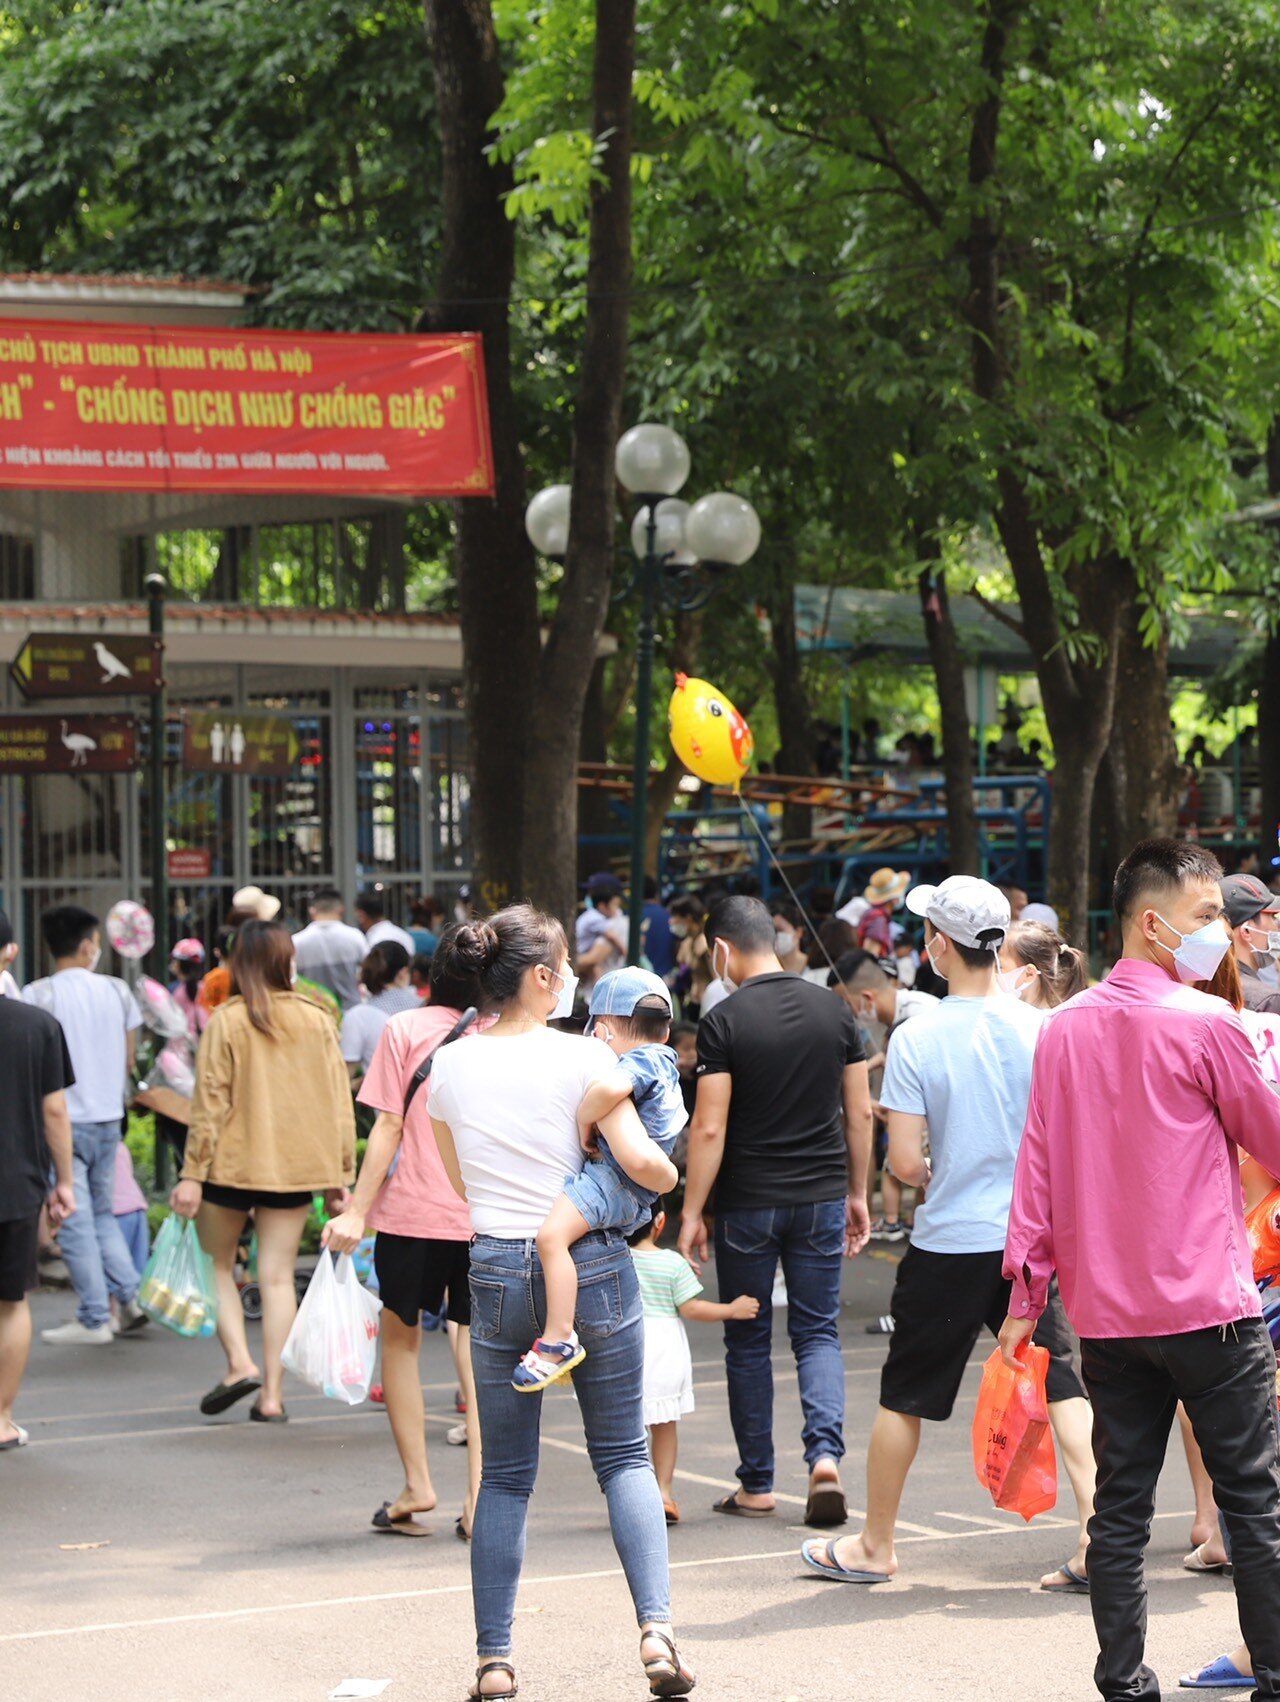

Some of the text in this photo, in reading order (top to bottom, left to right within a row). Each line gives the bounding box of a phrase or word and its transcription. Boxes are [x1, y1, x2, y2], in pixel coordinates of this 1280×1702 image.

[40, 340, 84, 368] TỊCH
[87, 343, 140, 367] UBND
[143, 342, 206, 369] THÀNH
[208, 342, 247, 371] PHỐ
[250, 346, 277, 371] HÀ
[280, 347, 313, 377] NỘI
[171, 388, 235, 434] DỊCH
[238, 389, 294, 428] NHƯ
[299, 382, 383, 428] CHỐNG
